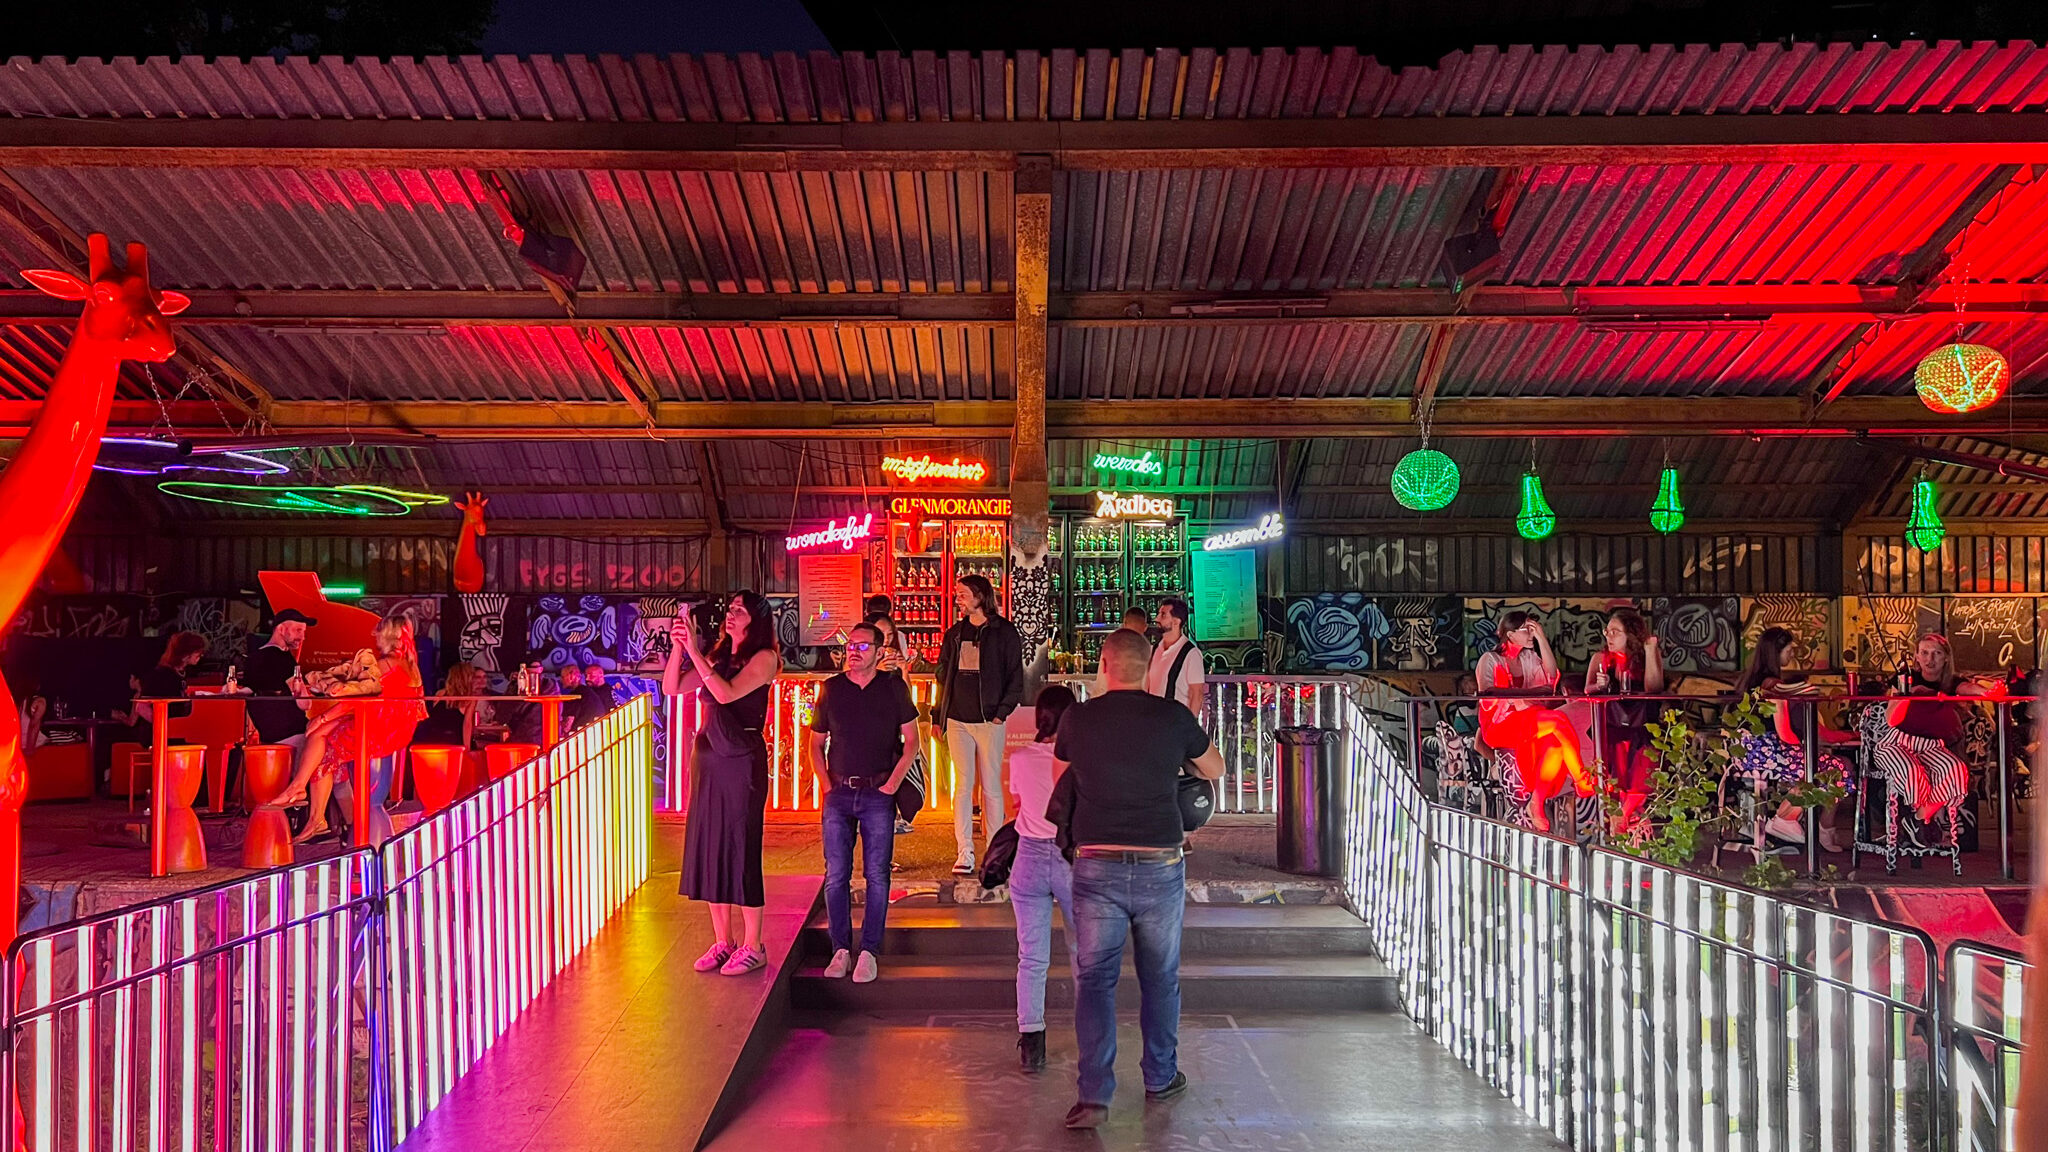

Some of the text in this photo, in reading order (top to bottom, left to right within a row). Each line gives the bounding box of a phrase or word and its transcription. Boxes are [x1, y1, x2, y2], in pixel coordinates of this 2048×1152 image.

[1093, 451, 1161, 475] weirdos
[891, 497, 1011, 515] GLENMORANGIE
[1096, 490, 1173, 518] Ardbeg
[785, 513, 872, 550] wonderful
[1203, 513, 1284, 551] assemble
